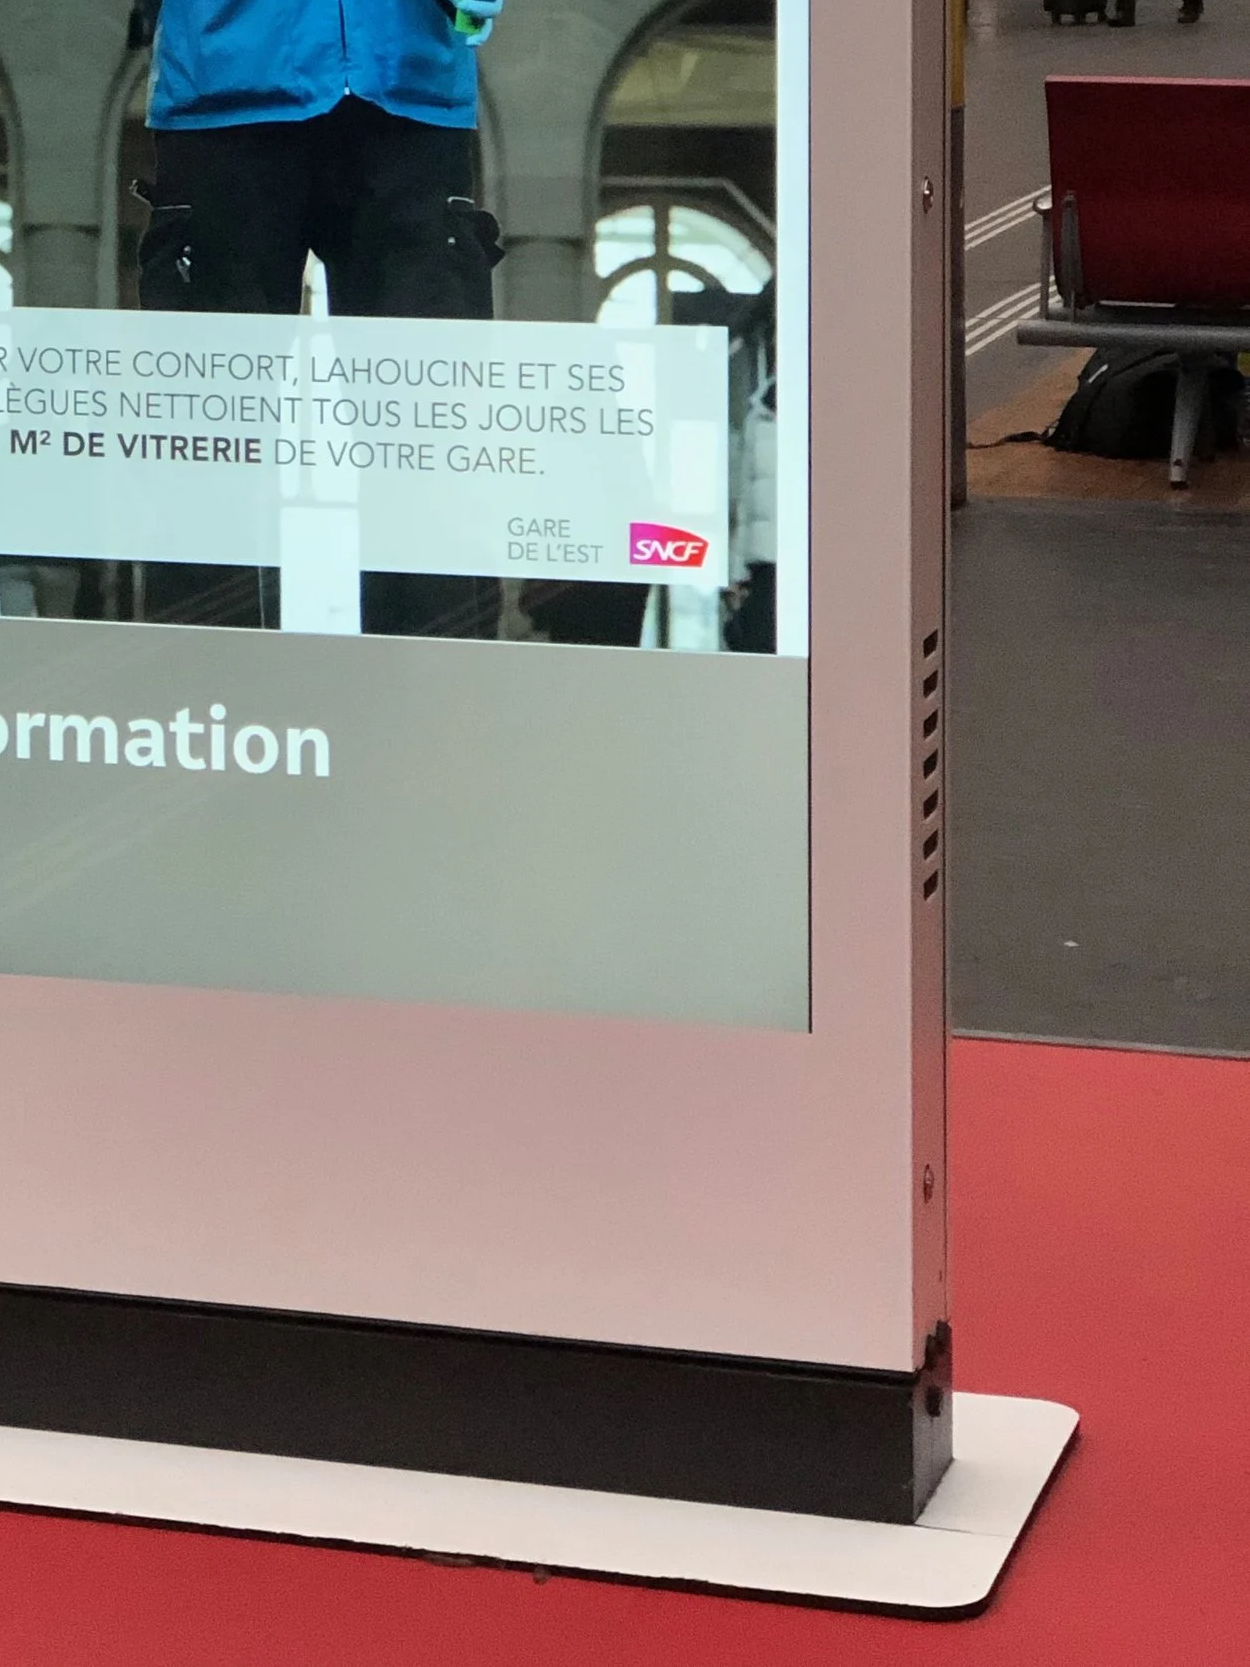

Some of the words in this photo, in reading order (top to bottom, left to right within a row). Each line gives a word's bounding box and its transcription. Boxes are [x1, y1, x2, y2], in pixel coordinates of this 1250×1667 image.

[17, 347, 121, 376] VOTRE
[132, 351, 300, 386] CONFORT,
[311, 356, 506, 389] LAHOUCINE
[518, 362, 557, 390] ET
[568, 364, 626, 393] SES
[120, 392, 303, 424] NETTOIENT
[314, 398, 401, 428] TOUS
[414, 401, 467, 430] LES
[479, 404, 587, 435] JOURS
[600, 408, 655, 436] LES
[10, 429, 51, 455] M²
[63, 432, 106, 458] DE
[117, 433, 262, 464] VITRERIE
[274, 439, 318, 466] DE
[327, 441, 436, 471] VOTRE
[447, 444, 546, 476] GARE.
[507, 517, 571, 538] GARE
[507, 542, 539, 561] DE
[546, 543, 604, 564] L'EST
[632, 539, 703, 561] SNCF
